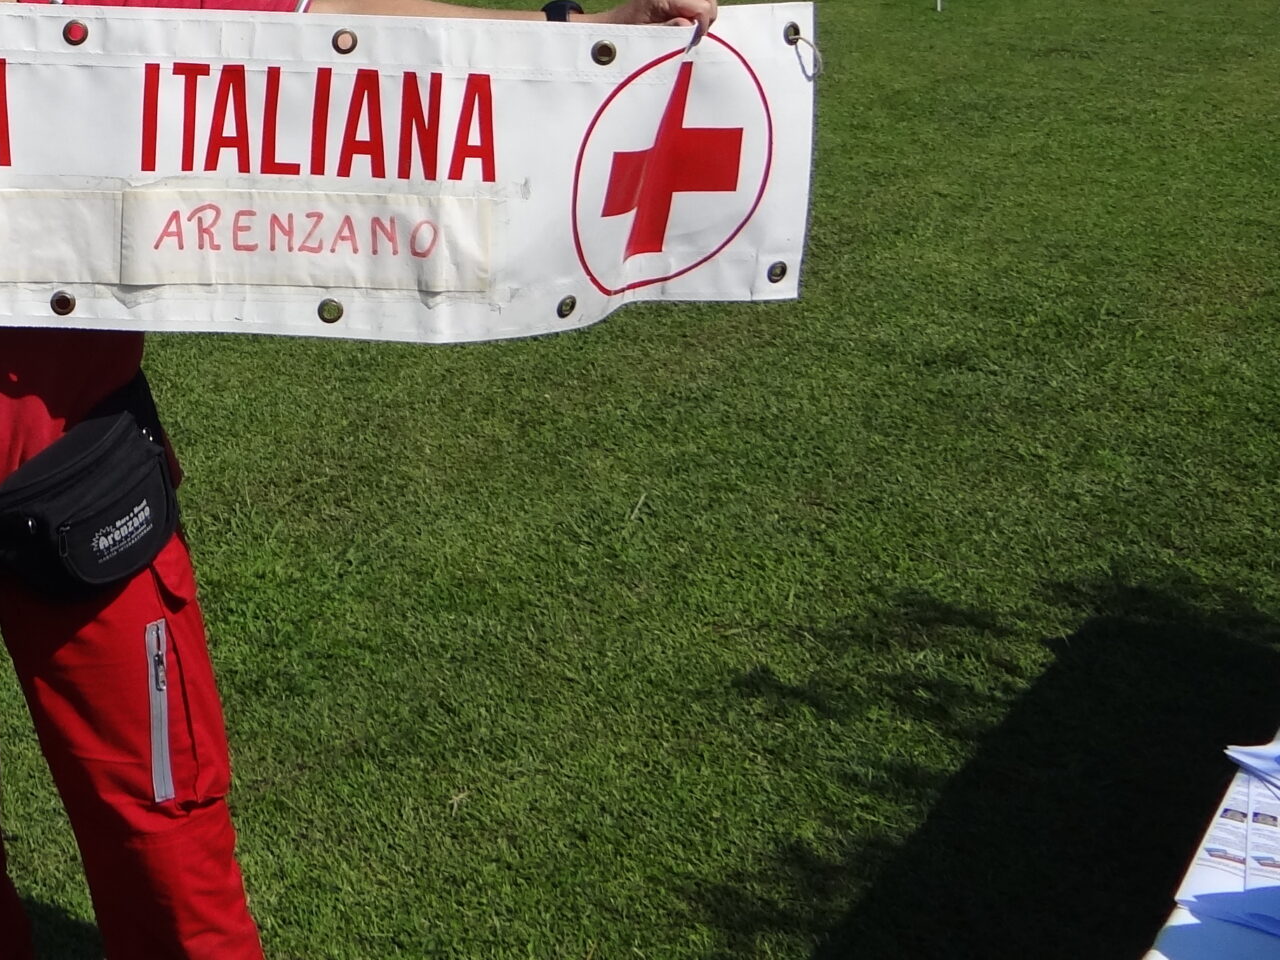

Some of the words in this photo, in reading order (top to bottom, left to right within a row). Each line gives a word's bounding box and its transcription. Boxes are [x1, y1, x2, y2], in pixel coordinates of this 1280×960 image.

[141, 62, 497, 183] ITALIANA
[153, 202, 439, 259] ARENZANO
[99, 506, 150, 550] Arenzano
